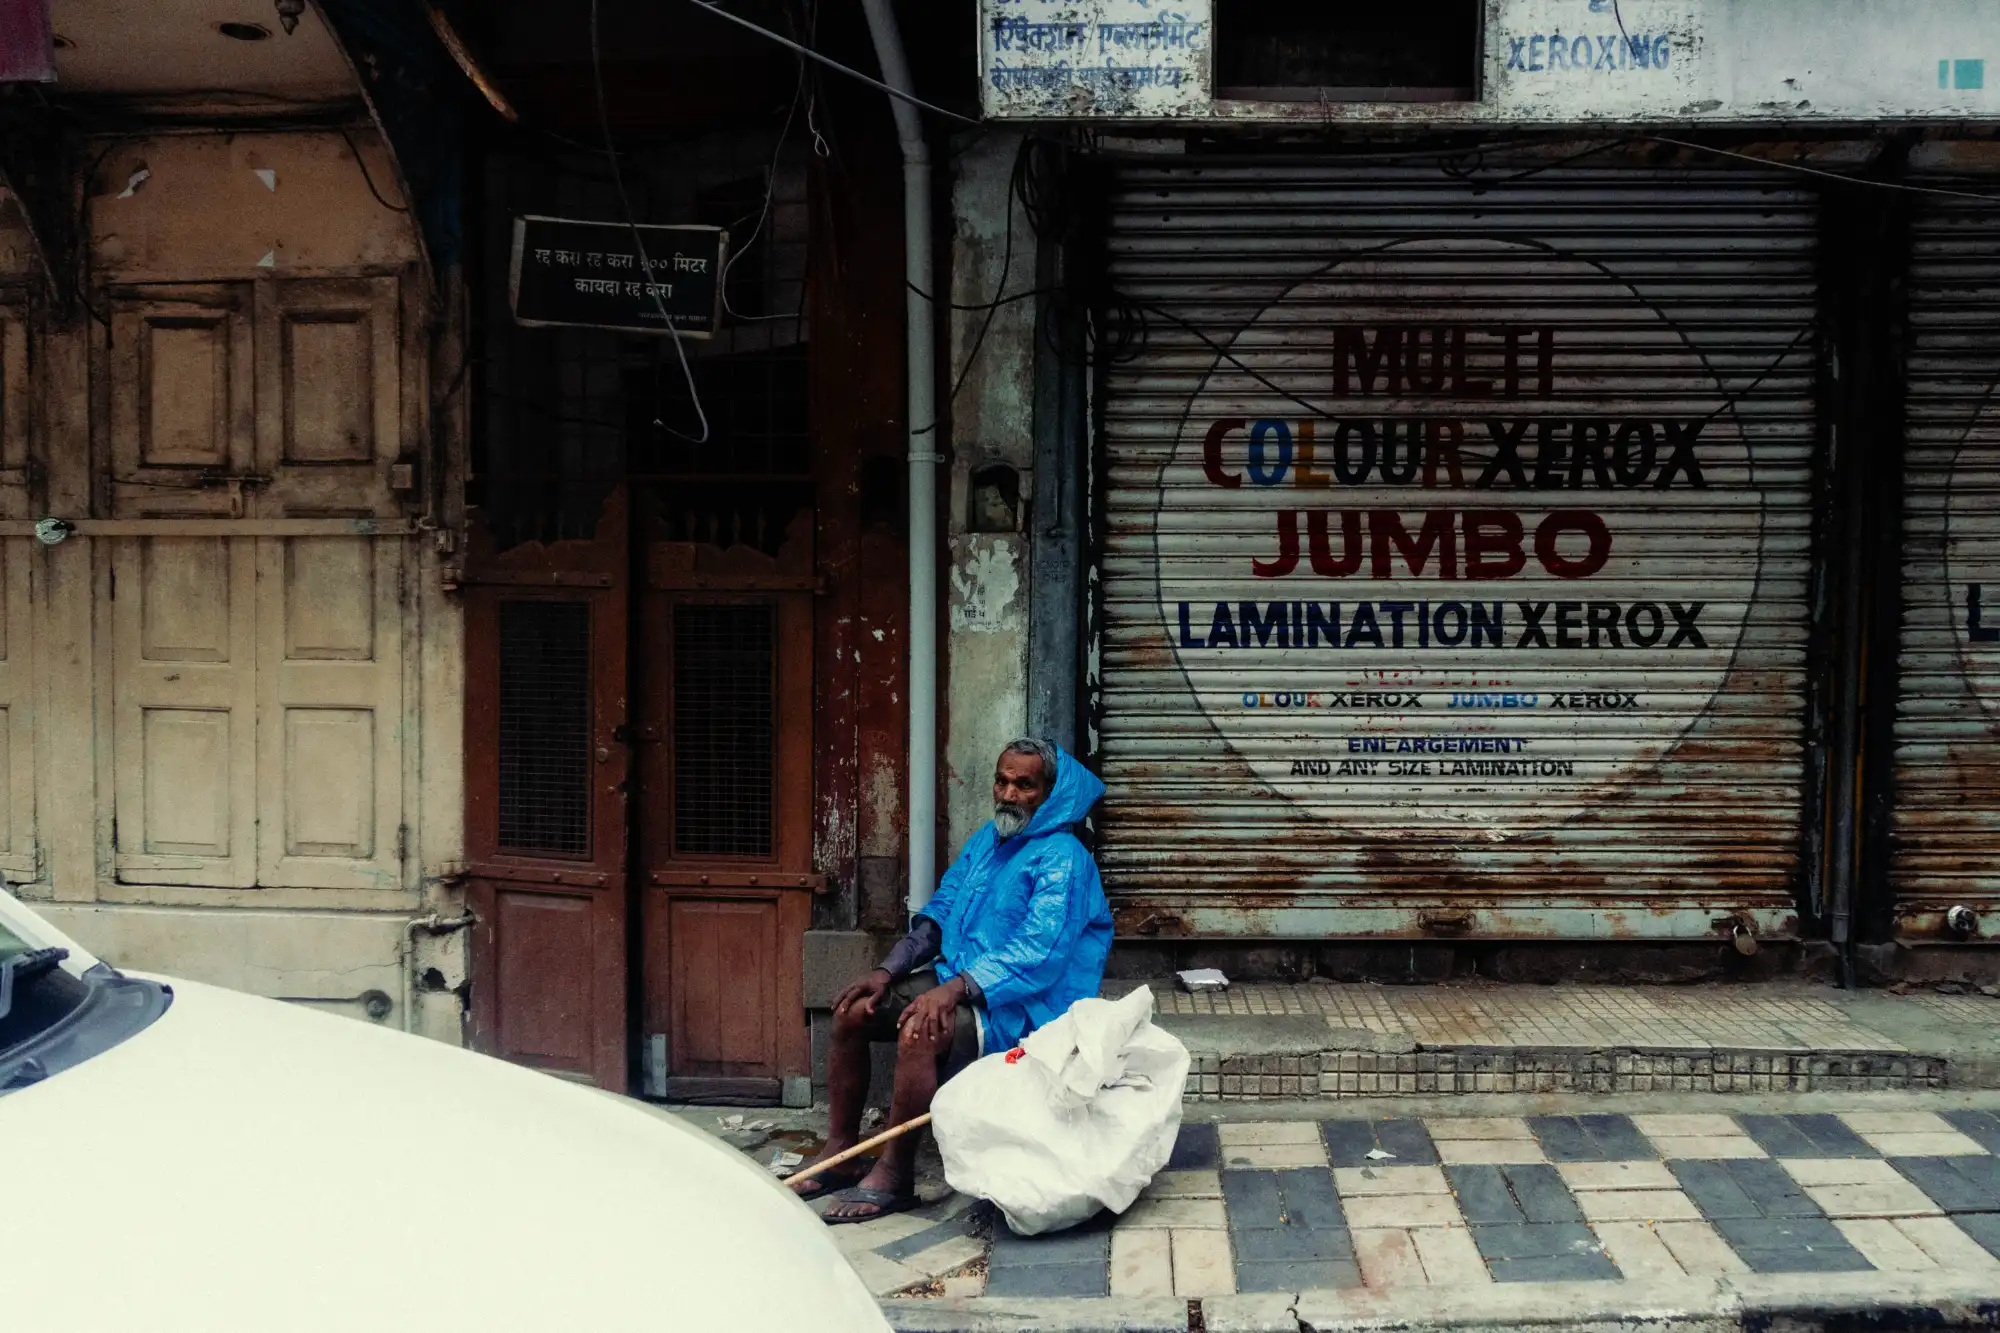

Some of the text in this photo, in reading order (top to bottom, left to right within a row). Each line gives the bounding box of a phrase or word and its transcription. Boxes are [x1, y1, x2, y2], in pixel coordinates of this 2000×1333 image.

[1507, 32, 1671, 73] XEROXING
[606, 253, 634, 269] करा
[673, 252, 707, 273] मिटर
[575, 278, 619, 297] कायदा
[625, 281, 641, 299] रद्द
[1332, 323, 1556, 398] MULTI
[1203, 417, 1709, 491] COLOUR XEROX
[1252, 509, 1613, 580] JUMBO
[1177, 600, 1709, 650] LAMINATION XEROX
[1328, 691, 1424, 709] XEROX
[1447, 691, 1539, 709] JUMBO
[1549, 691, 1640, 709] XEROX
[1347, 737, 1526, 754] ENLARGEMENT
[1290, 759, 1574, 777] AND ANY SIZE LAMINATION
